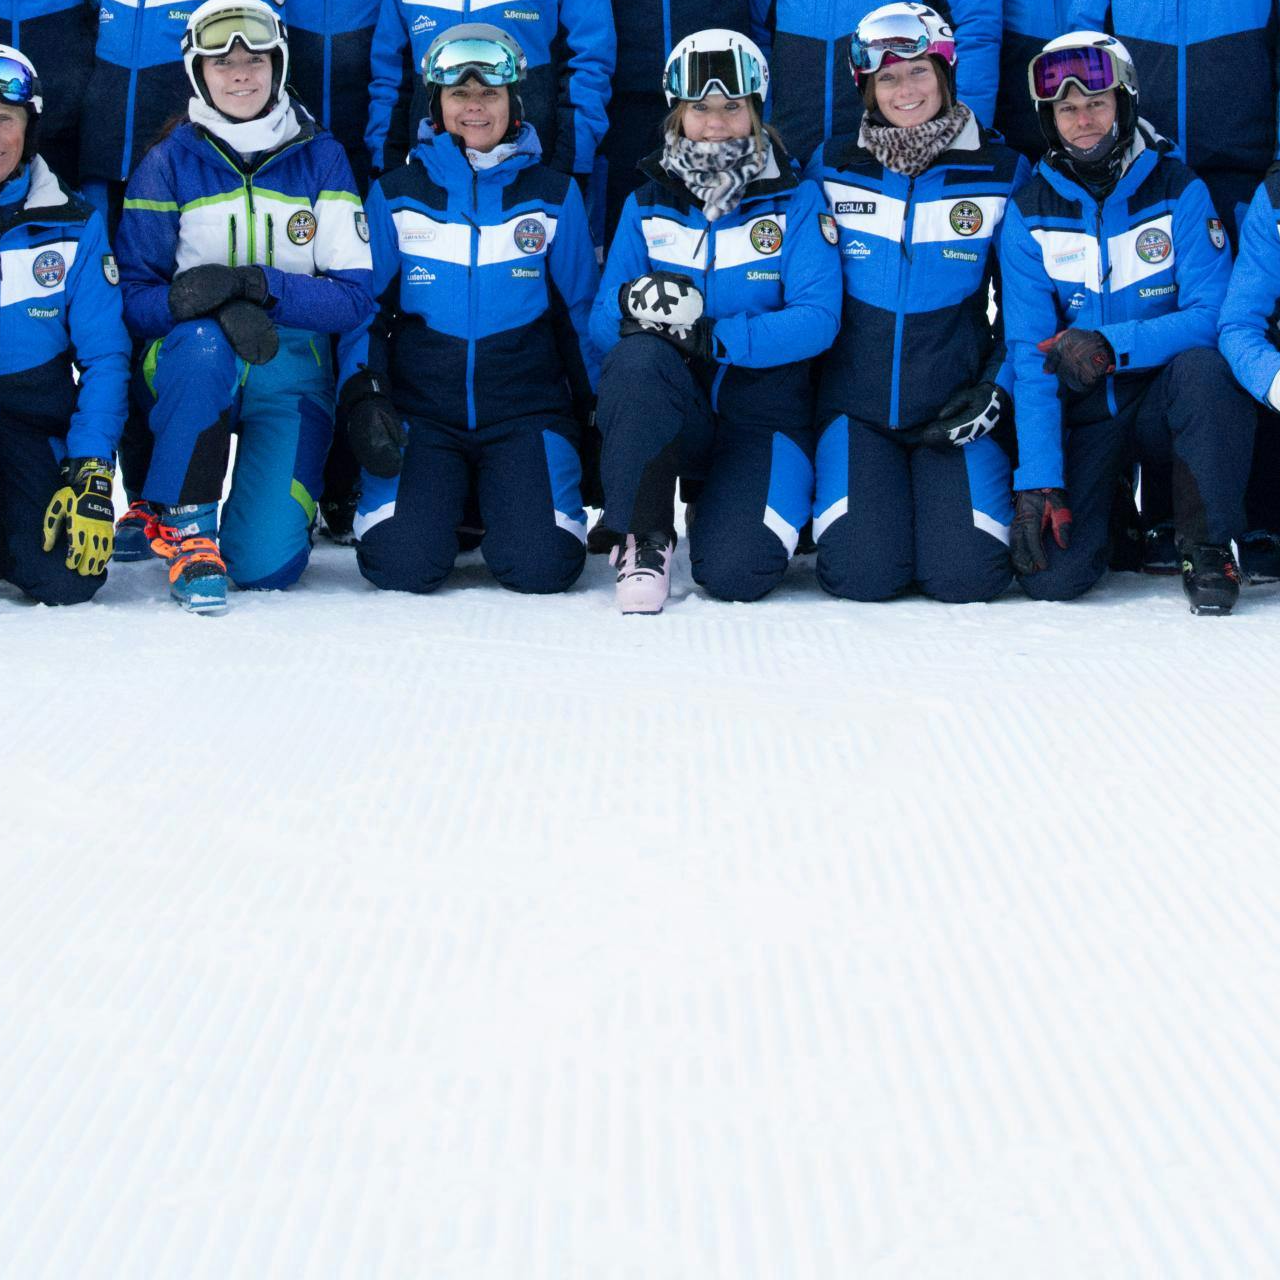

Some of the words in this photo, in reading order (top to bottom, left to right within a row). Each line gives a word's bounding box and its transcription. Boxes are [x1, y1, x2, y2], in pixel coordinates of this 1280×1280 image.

[504, 10, 540, 21] S.Bernardo
[837, 202, 864, 213] CECILIA
[867, 202, 874, 213] R
[943, 249, 978, 262] S.Bernardo
[88, 502, 113, 516] LEVEL
